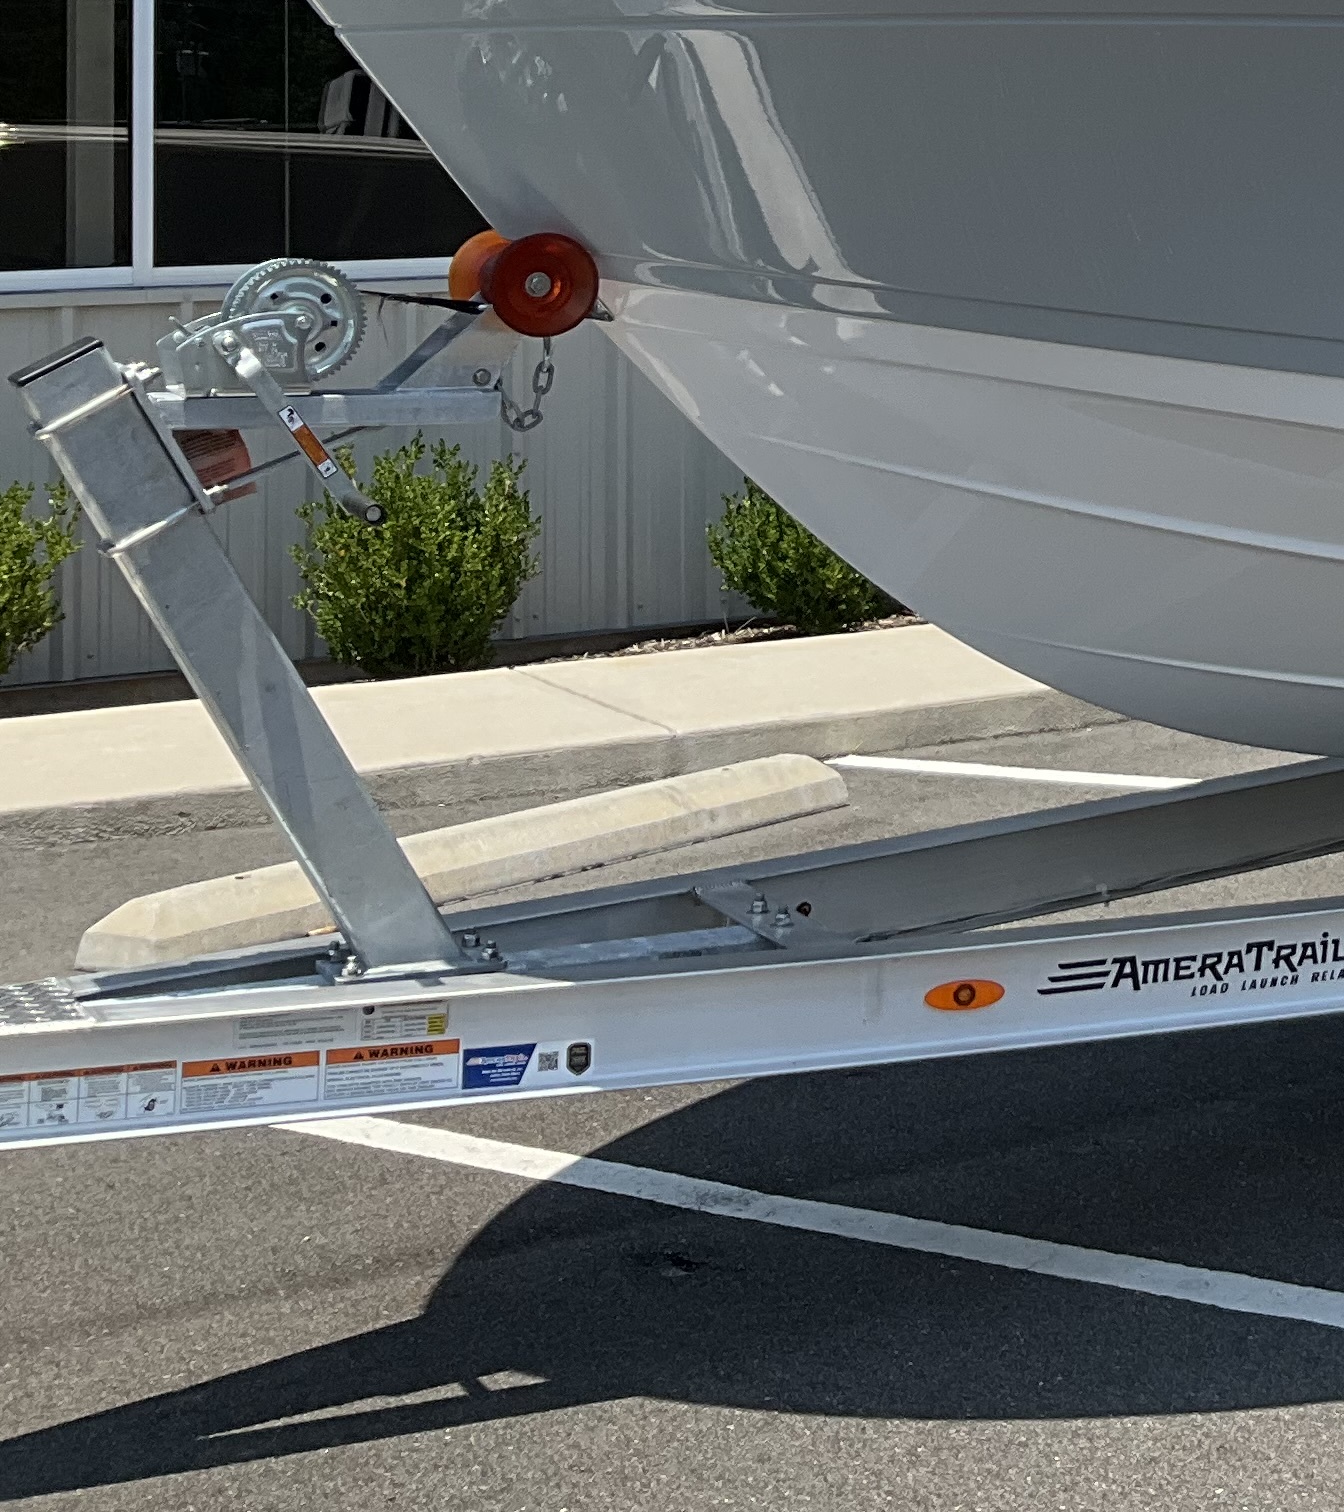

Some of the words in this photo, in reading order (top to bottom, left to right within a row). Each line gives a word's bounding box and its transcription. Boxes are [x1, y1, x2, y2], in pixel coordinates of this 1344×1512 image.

[1190, 982, 1229, 998] LOAD
[1240, 974, 1299, 992] LAUNCH
[368, 1044, 434, 1059] WARNING
[225, 1055, 293, 1071] WARNING
